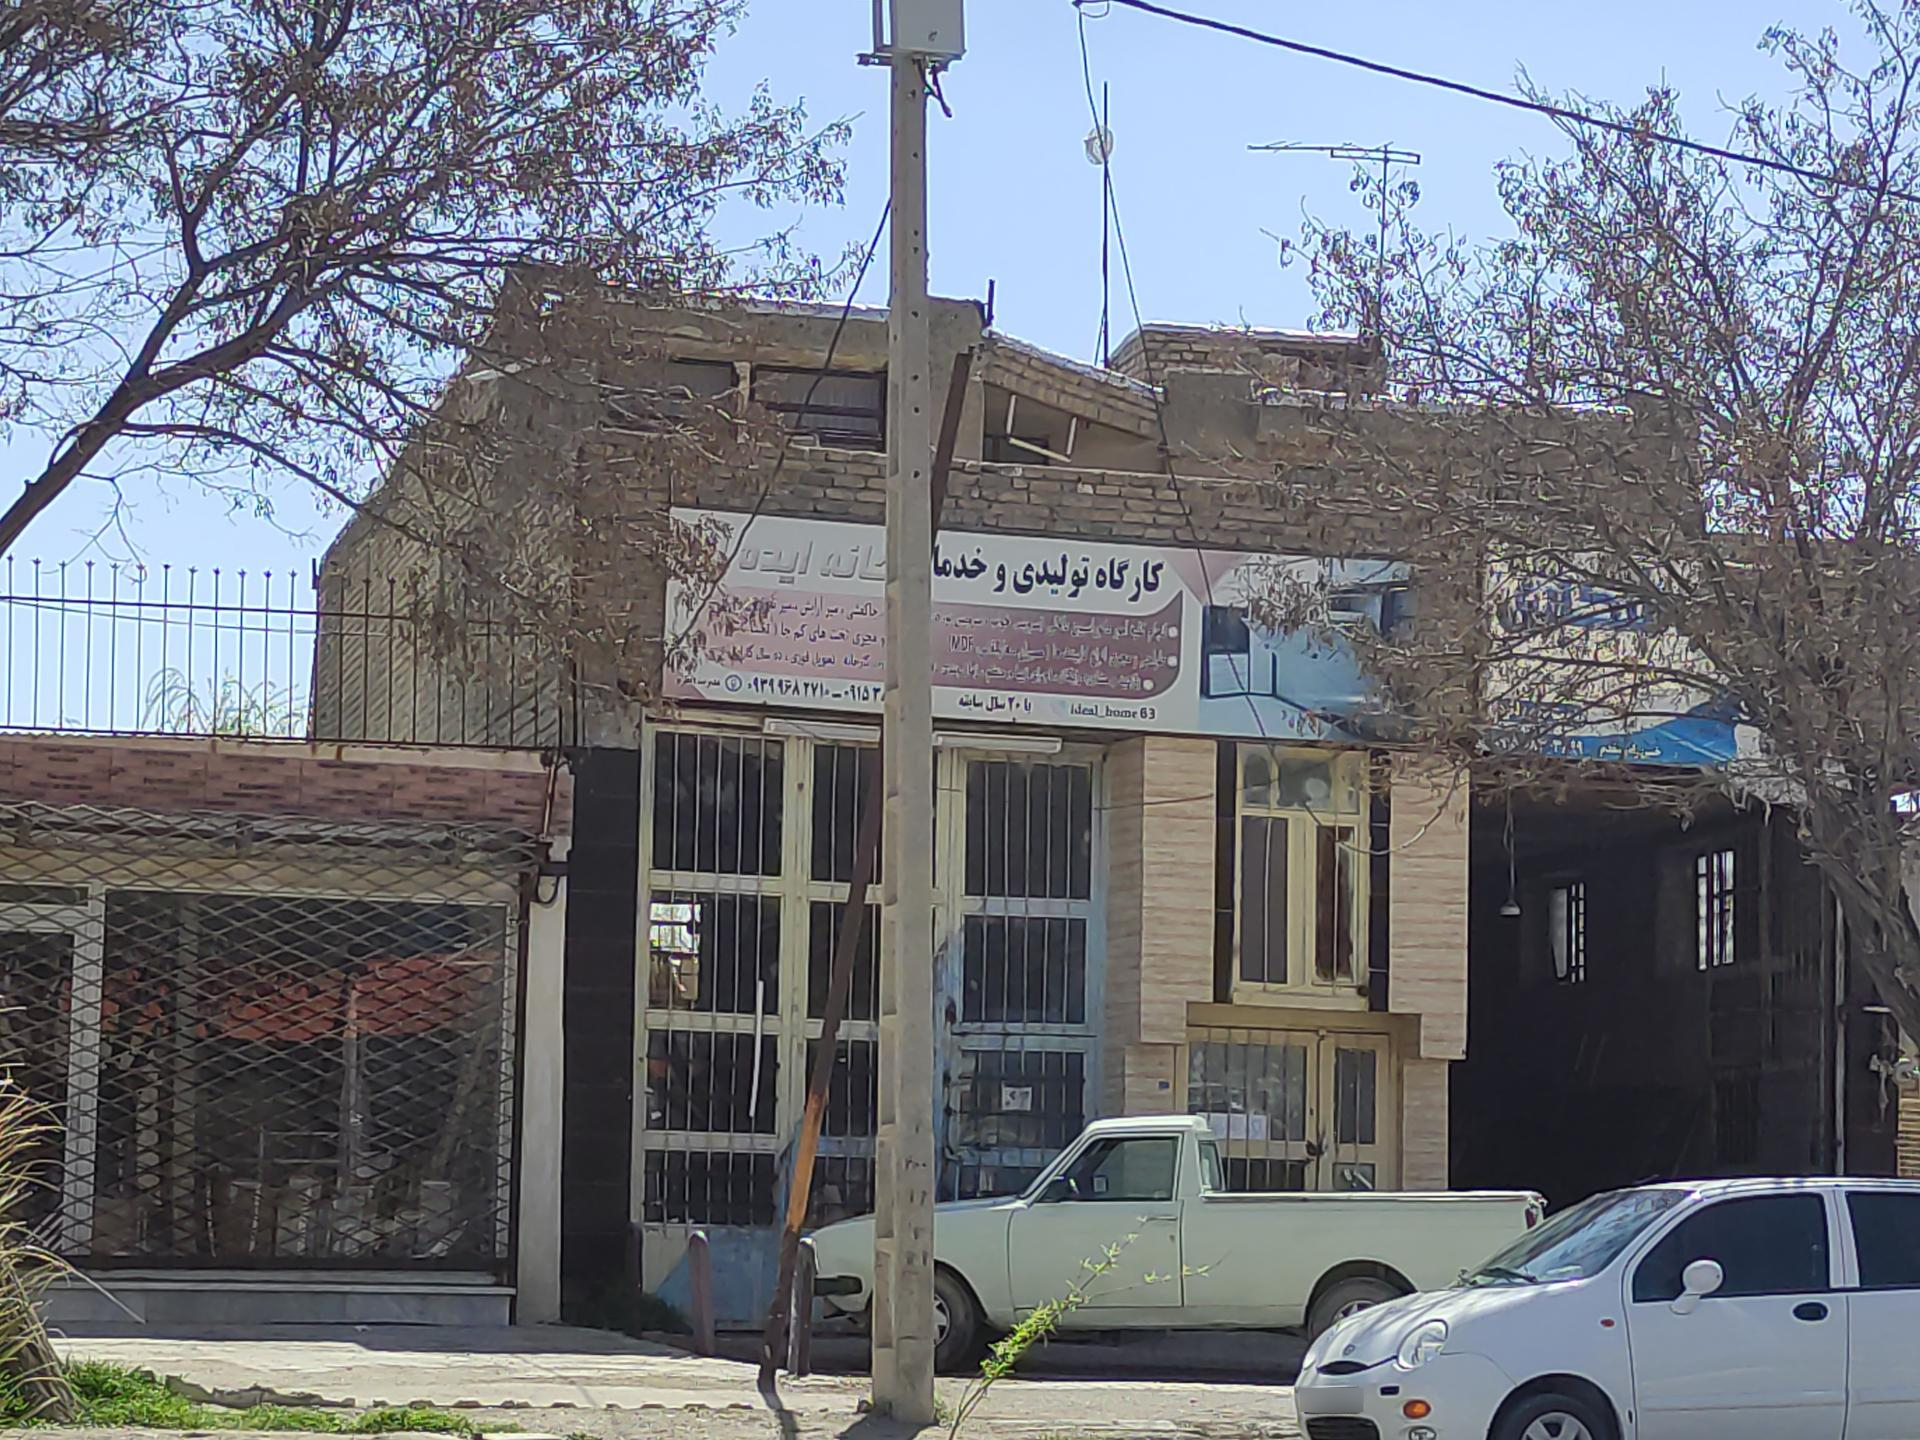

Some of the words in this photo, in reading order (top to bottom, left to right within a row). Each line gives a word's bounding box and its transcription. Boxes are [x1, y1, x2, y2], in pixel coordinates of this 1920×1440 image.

[933, 545, 987, 579] خدما
[993, 562, 1006, 592] و
[1013, 552, 1090, 597] تولیدی
[1096, 555, 1164, 602] کارگاه
[986, 696, 1006, 712] سال
[1008, 696, 1020, 712] ۲۰
[1024, 697, 1032, 714] با
